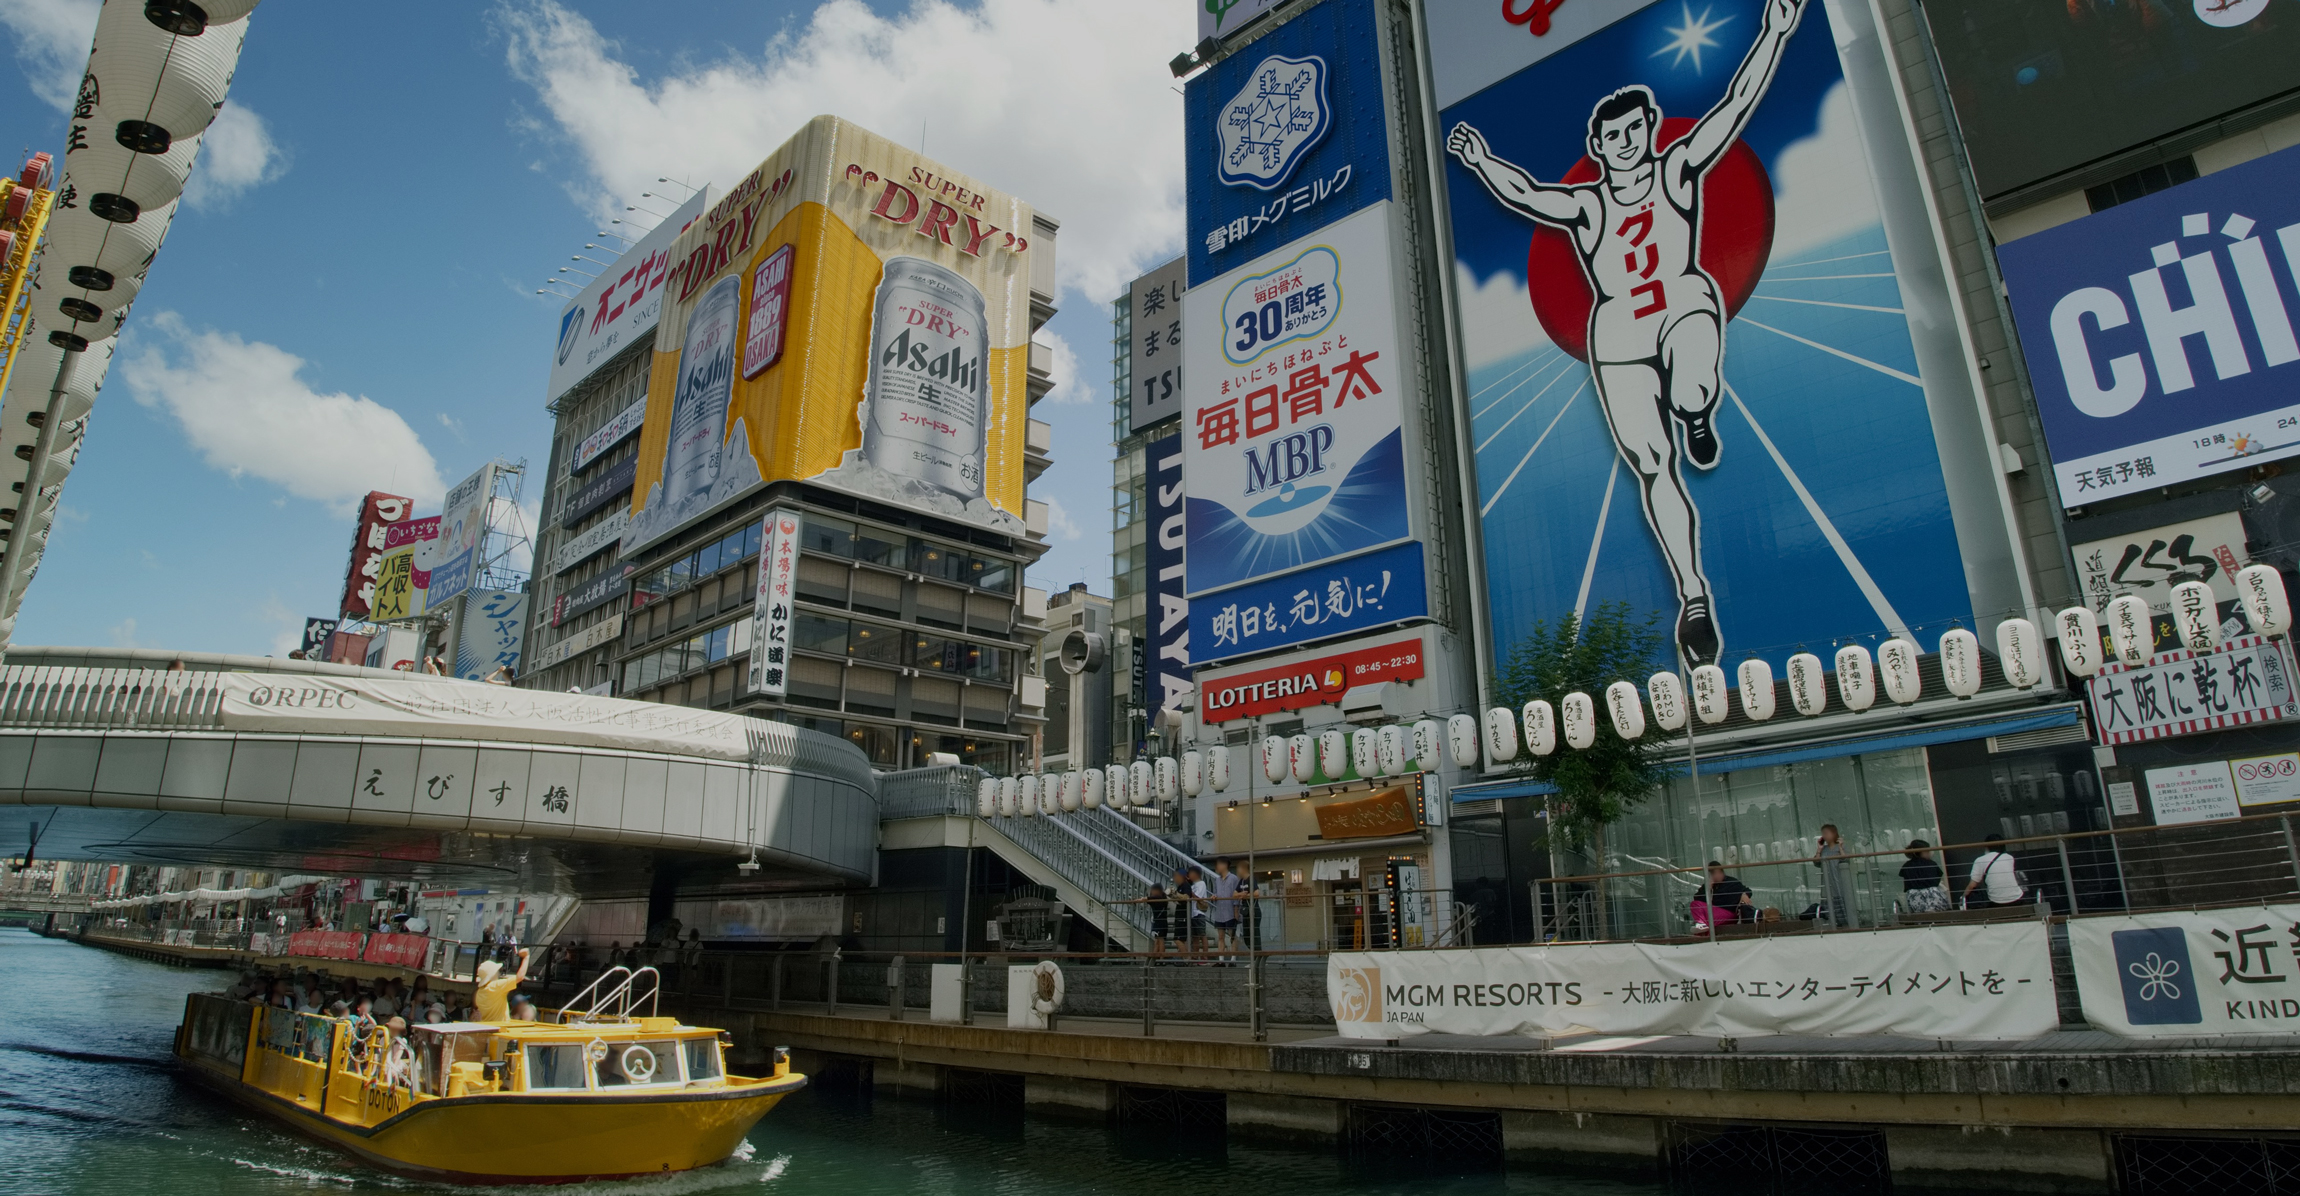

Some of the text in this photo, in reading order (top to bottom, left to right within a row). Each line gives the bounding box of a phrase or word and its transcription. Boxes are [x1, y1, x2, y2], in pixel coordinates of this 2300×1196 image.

[706, 169, 762, 232] SUPER
[908, 166, 985, 212] SUPER
[1205, 164, 1352, 255] 雪印メグミルク
[752, 253, 786, 302] ASAHI
[1615, 201, 1668, 320] グリコ
[758, 290, 775, 307] since
[1254, 275, 1304, 304] 毎日骨太
[632, 298, 660, 330] SINCE
[702, 318, 721, 336] SUPER
[749, 294, 783, 340] 1889
[919, 300, 954, 319] SUPER
[1235, 282, 1327, 352] 30周年
[1285, 306, 1328, 332] ありがとう
[745, 327, 778, 373] OSAKA
[882, 327, 977, 394] Asahi
[1221, 334, 1348, 395] まいにちほねぶと
[678, 341, 730, 413] Asahi
[917, 382, 942, 406] 生
[693, 400, 706, 421] 生
[1196, 350, 1383, 451] 毎日骨太
[900, 412, 957, 437] スーパードライ
[1244, 423, 1335, 497] MBP
[2075, 455, 2156, 493] 天気予報
[564, 500, 577, 520] 7F
[376, 556, 399, 619] バイト
[388, 553, 414, 617] 高収入
[428, 568, 467, 606] ガルフネット
[759, 539, 772, 597] 本場の味
[775, 538, 793, 598] 本場の味
[583, 578, 607, 605] 大牧場
[547, 641, 571, 666] 白木屋
[1208, 673, 1320, 711] LOTTERIA
[2101, 653, 2262, 731] 大阪に乾杯
[2262, 655, 2285, 692] 検索
[379, 694, 517, 718] 一般社団法人
[1564, 702, 1578, 741] ろくだん
[1526, 709, 1541, 748] ろくだん
[363, 767, 570, 815] えびす橋
[1386, 981, 1582, 1008] MGM RESORTS
[1621, 968, 2006, 1005] 大阪に新しいエンターテイメントを
[1386, 1011, 1426, 1024] JAPAN
